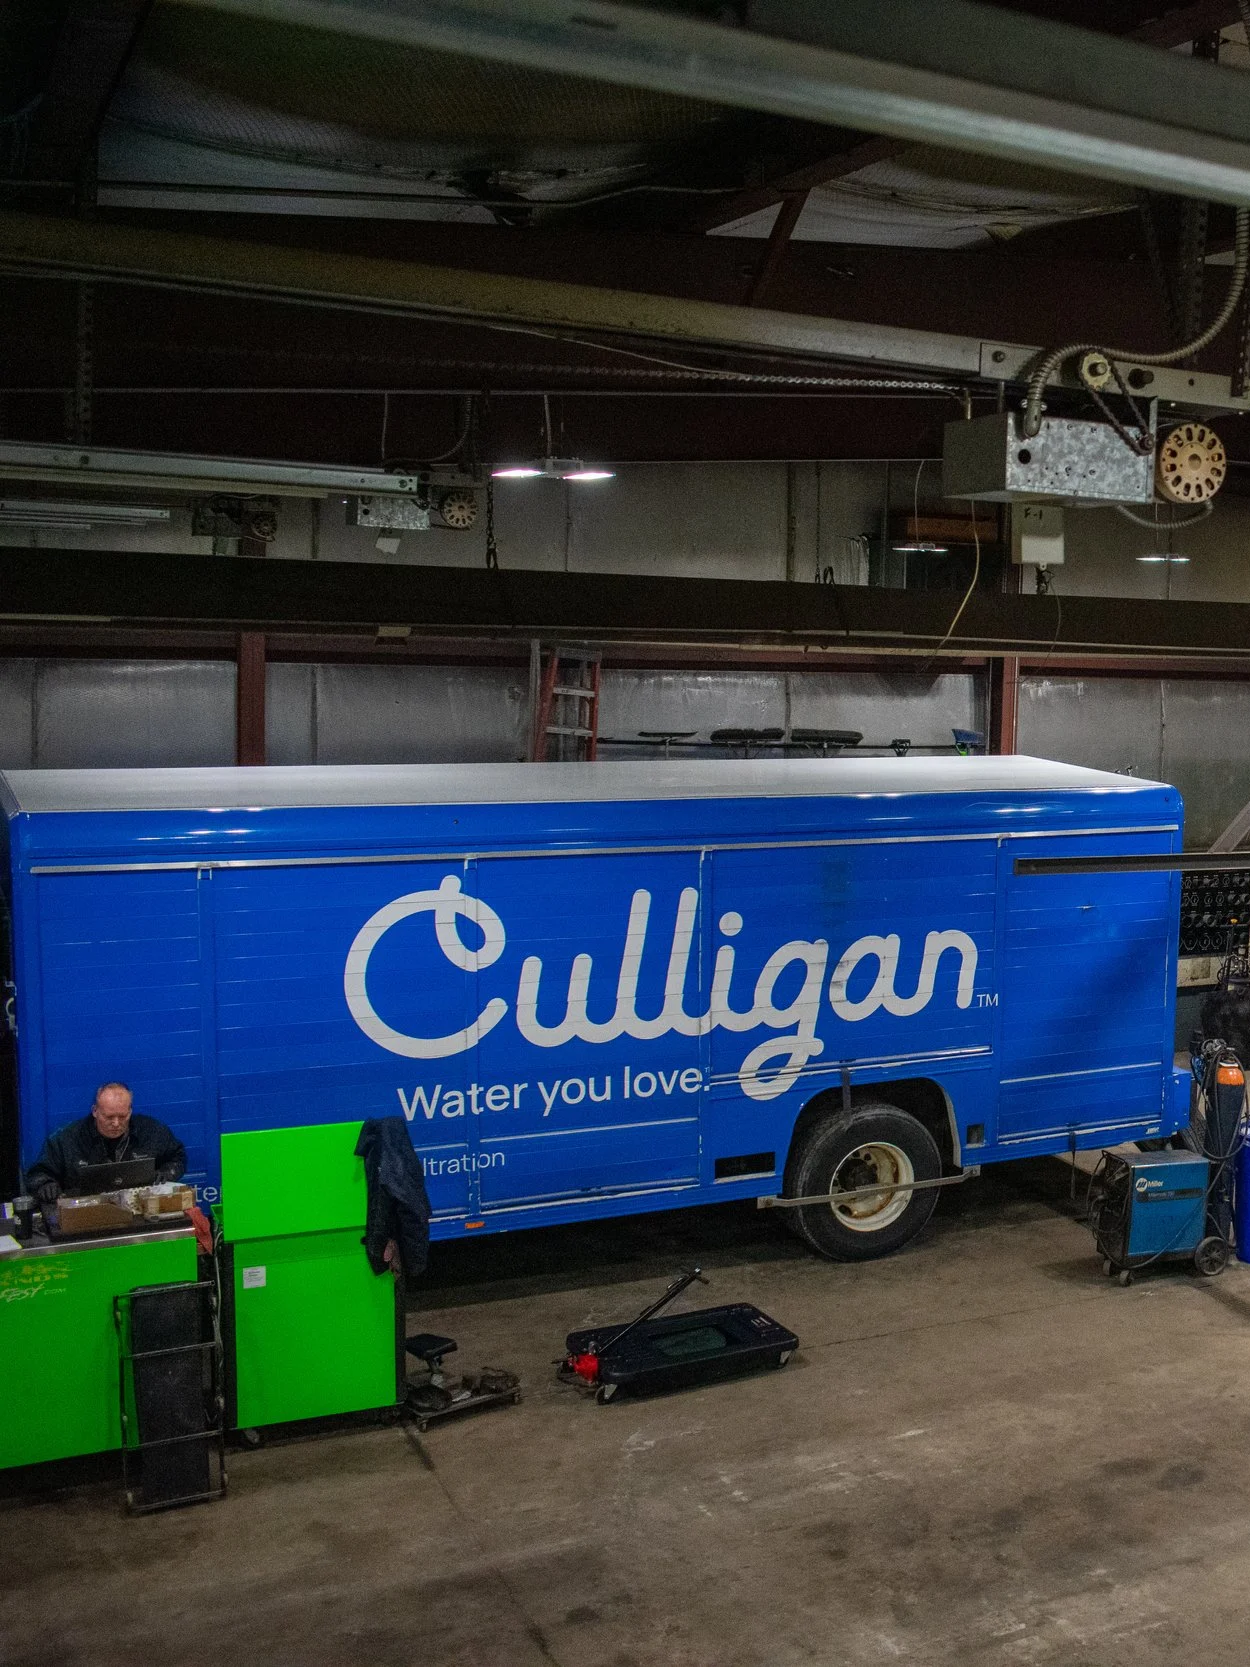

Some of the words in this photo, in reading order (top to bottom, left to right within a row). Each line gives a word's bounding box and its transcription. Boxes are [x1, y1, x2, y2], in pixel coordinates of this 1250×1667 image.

[343, 874, 979, 1101] Culligan
[397, 1082, 528, 1121] Water
[537, 1075, 611, 1117] you
[423, 1151, 505, 1177] ltration
